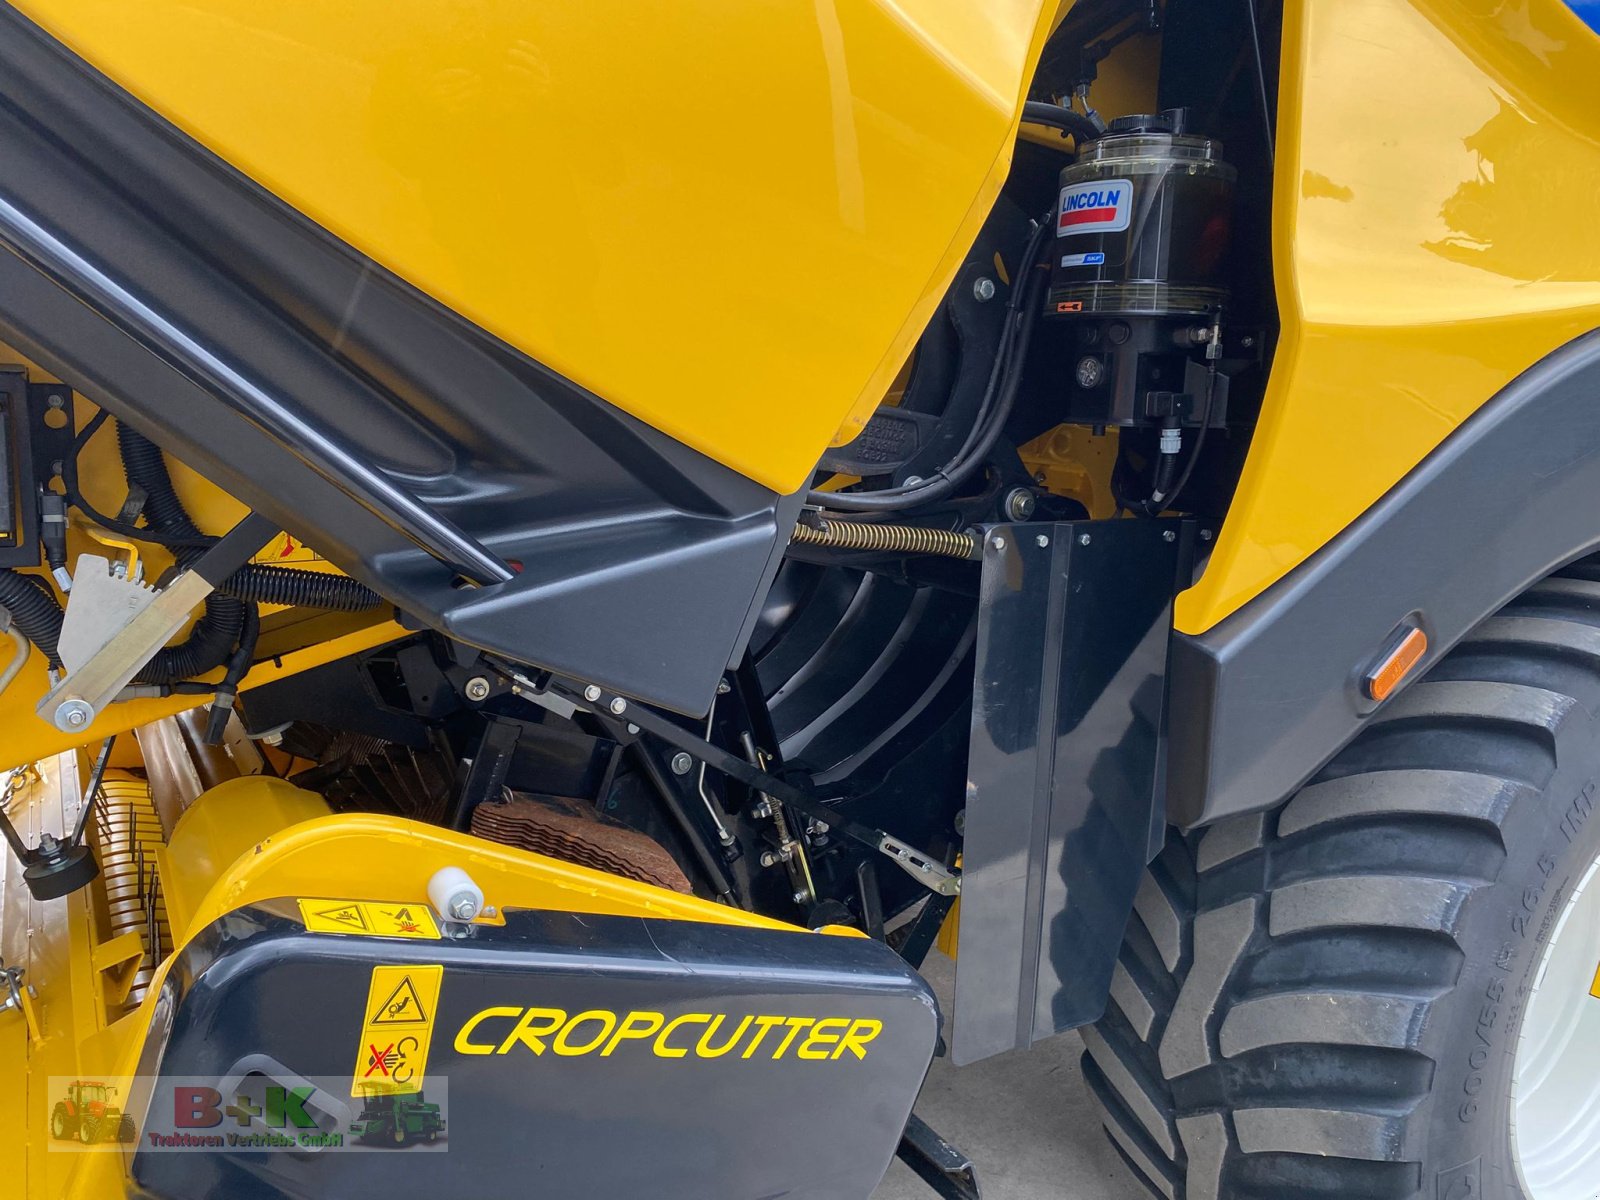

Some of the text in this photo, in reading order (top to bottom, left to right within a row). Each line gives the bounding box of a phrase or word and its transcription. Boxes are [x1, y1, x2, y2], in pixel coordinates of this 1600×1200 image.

[1062, 190, 1121, 212] LINCOLN
[454, 1006, 882, 1060] CROPCUTTER
[1458, 976, 1505, 1124] 600/55
